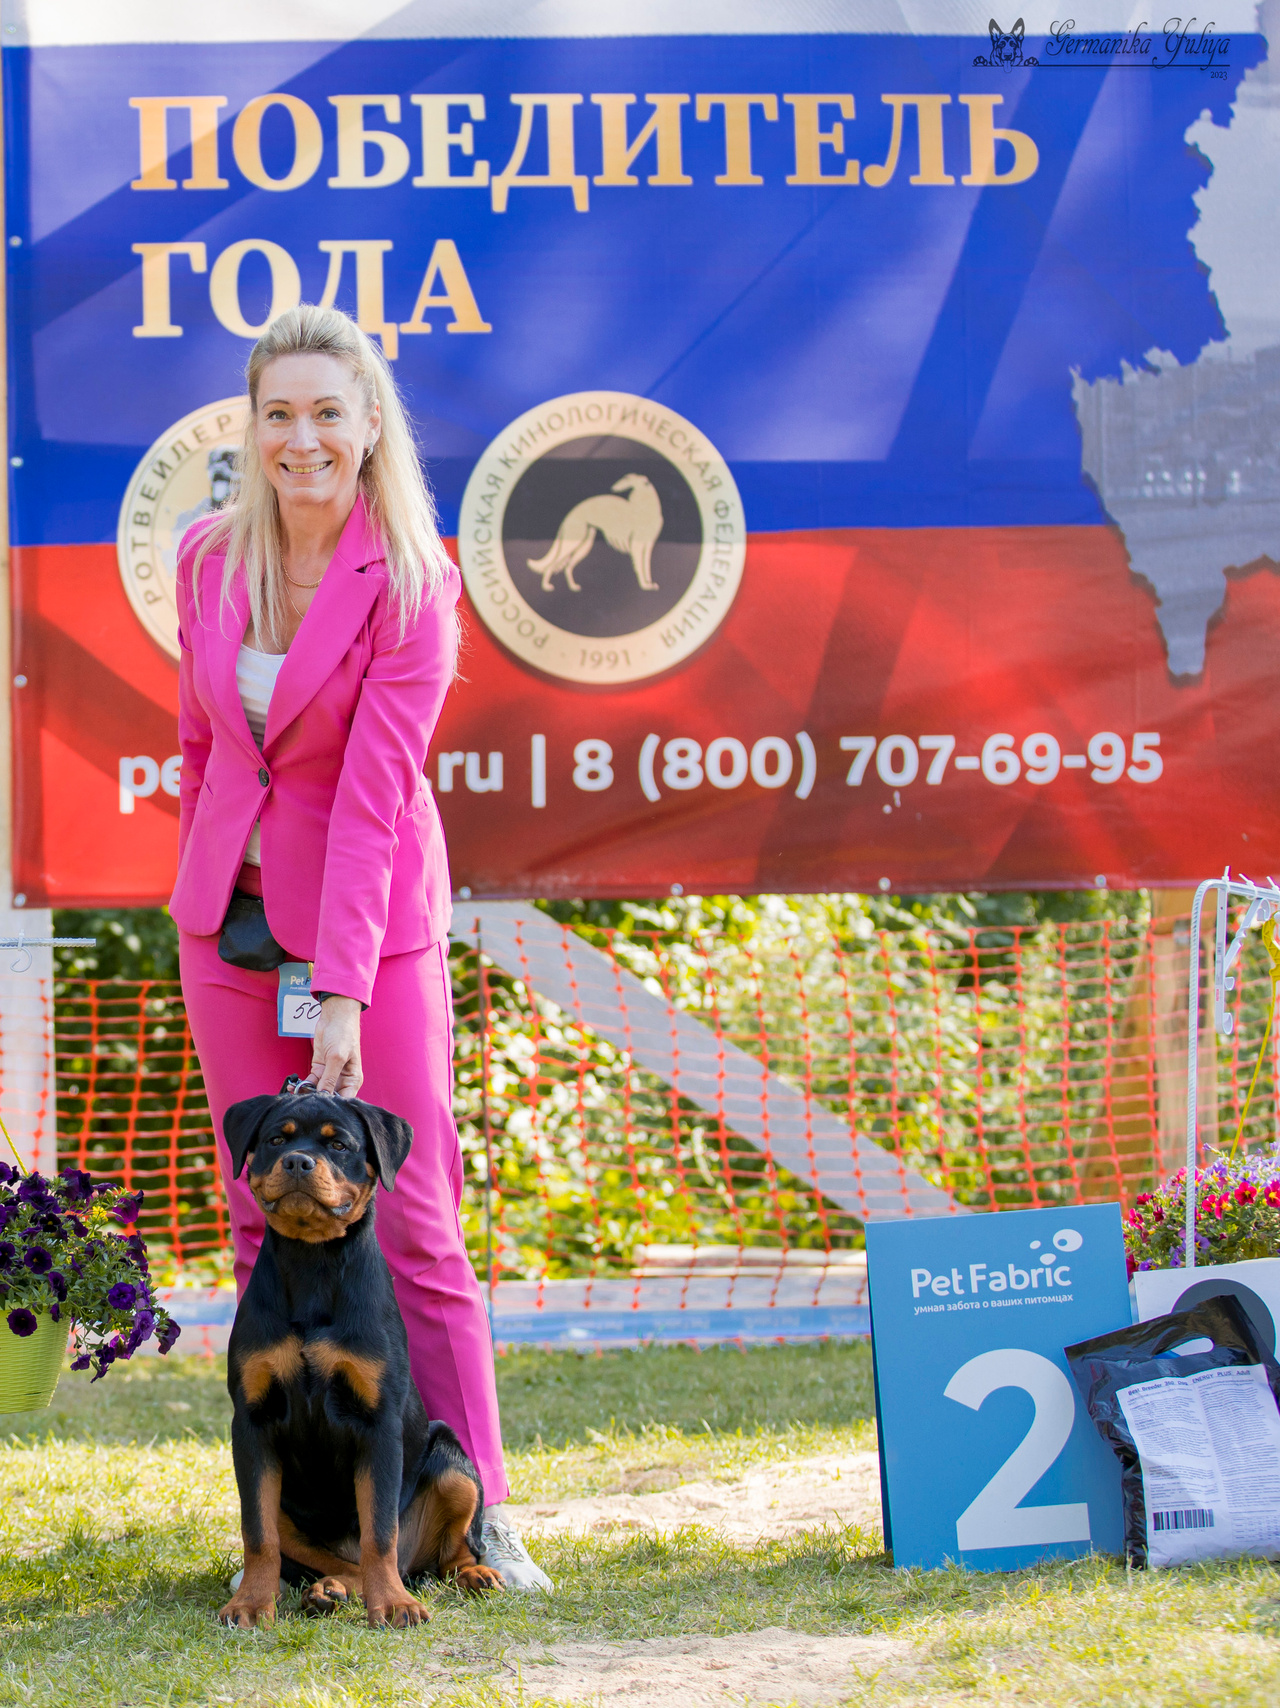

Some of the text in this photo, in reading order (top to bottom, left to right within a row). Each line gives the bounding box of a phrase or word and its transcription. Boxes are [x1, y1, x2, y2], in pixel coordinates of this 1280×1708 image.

[129, 92, 1040, 213] ПОБЕДИТЕЛЬ
[131, 238, 493, 359] ГОДА
[472, 403, 735, 650] РОССИЙСКАЯ КИНОЛОГИЧЕСКАЯ ФЕДЕРАЦИЯ
[579, 649, 632, 668] 1991
[119, 755, 182, 814] pe
[573, 739, 614, 791] 8
[639, 731, 817, 802] (800)
[840, 731, 1163, 787] 707-69-95
[290, 975, 304, 985] Pet
[911, 1263, 1072, 1298] Pet Fabric
[914, 1304, 945, 1315] умная
[947, 1301, 980, 1311] забота
[991, 1298, 1023, 1307] ваших
[1024, 1294, 1073, 1305] питомцах
[943, 1348, 1091, 1551] 2
